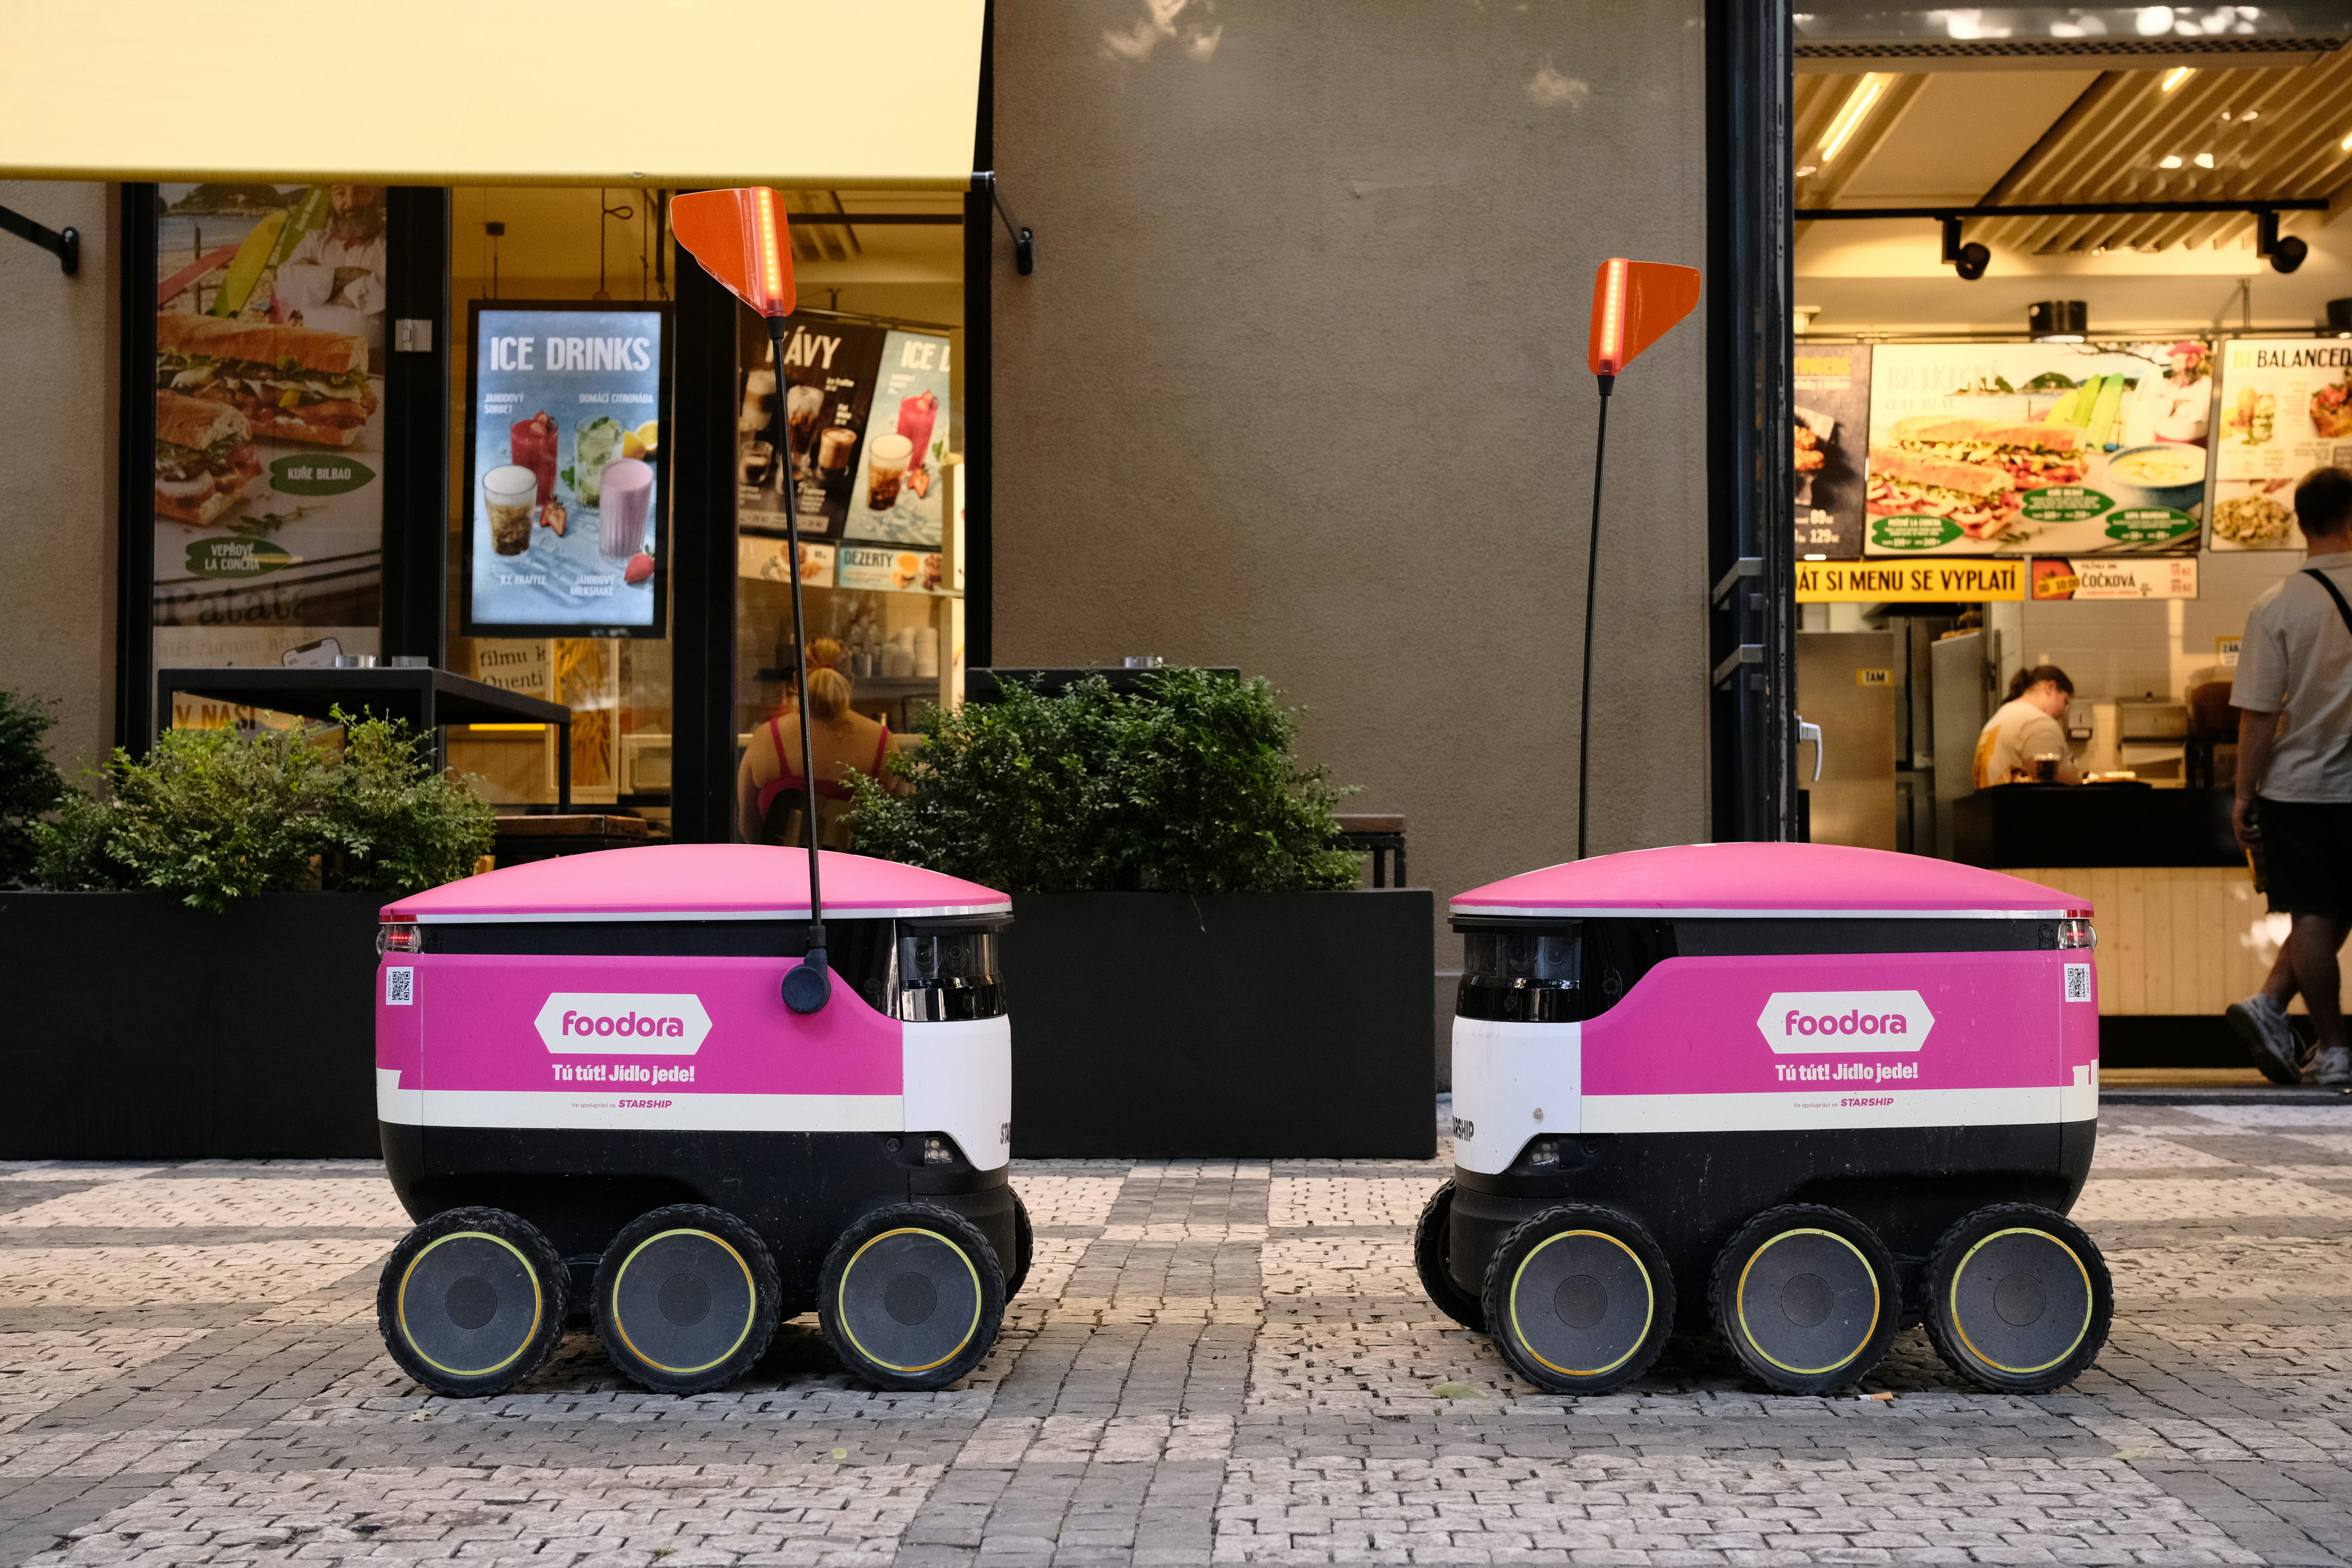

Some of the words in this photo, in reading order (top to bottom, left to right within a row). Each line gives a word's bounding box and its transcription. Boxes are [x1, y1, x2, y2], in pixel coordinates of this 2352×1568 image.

[491, 337, 534, 371] ICE
[547, 337, 651, 372] DRINKS
[901, 340, 937, 371] ICE
[2257, 348, 2352, 368] BALANCED
[484, 392, 525, 403] JAHODOVÝ
[484, 404, 512, 414] SORBET
[287, 465, 313, 480] KUŘE
[316, 467, 351, 480] BILBAO
[211, 542, 254, 557] VEPŘOVÉ
[205, 558, 217, 571] LA
[221, 558, 260, 571] CONCHA
[844, 551, 893, 567] DEZERTY
[1795, 566, 1819, 591] ÁT
[1826, 570, 1842, 591] SI
[1850, 570, 1903, 591] MENU
[1911, 570, 1932, 591] SE
[1940, 565, 2015, 591] VYPLATÍ
[2081, 572, 2136, 587] ČOČKOVÁ
[1866, 672, 1885, 682] TAM
[562, 1010, 684, 1037] foodora
[1785, 1009, 1907, 1035] foodora
[552, 1064, 573, 1081] Tú
[575, 1064, 606, 1081] tút!
[609, 1065, 650, 1081] Jídlo
[651, 1066, 695, 1086] jede!
[1775, 1064, 1796, 1081] Tú
[1799, 1064, 1830, 1081] tút!
[1833, 1063, 1874, 1080] Jídlo
[1876, 1062, 1918, 1083] jede!
[619, 1099, 672, 1108] STARSHIP
[1841, 1098, 1894, 1107] STARSHIP
